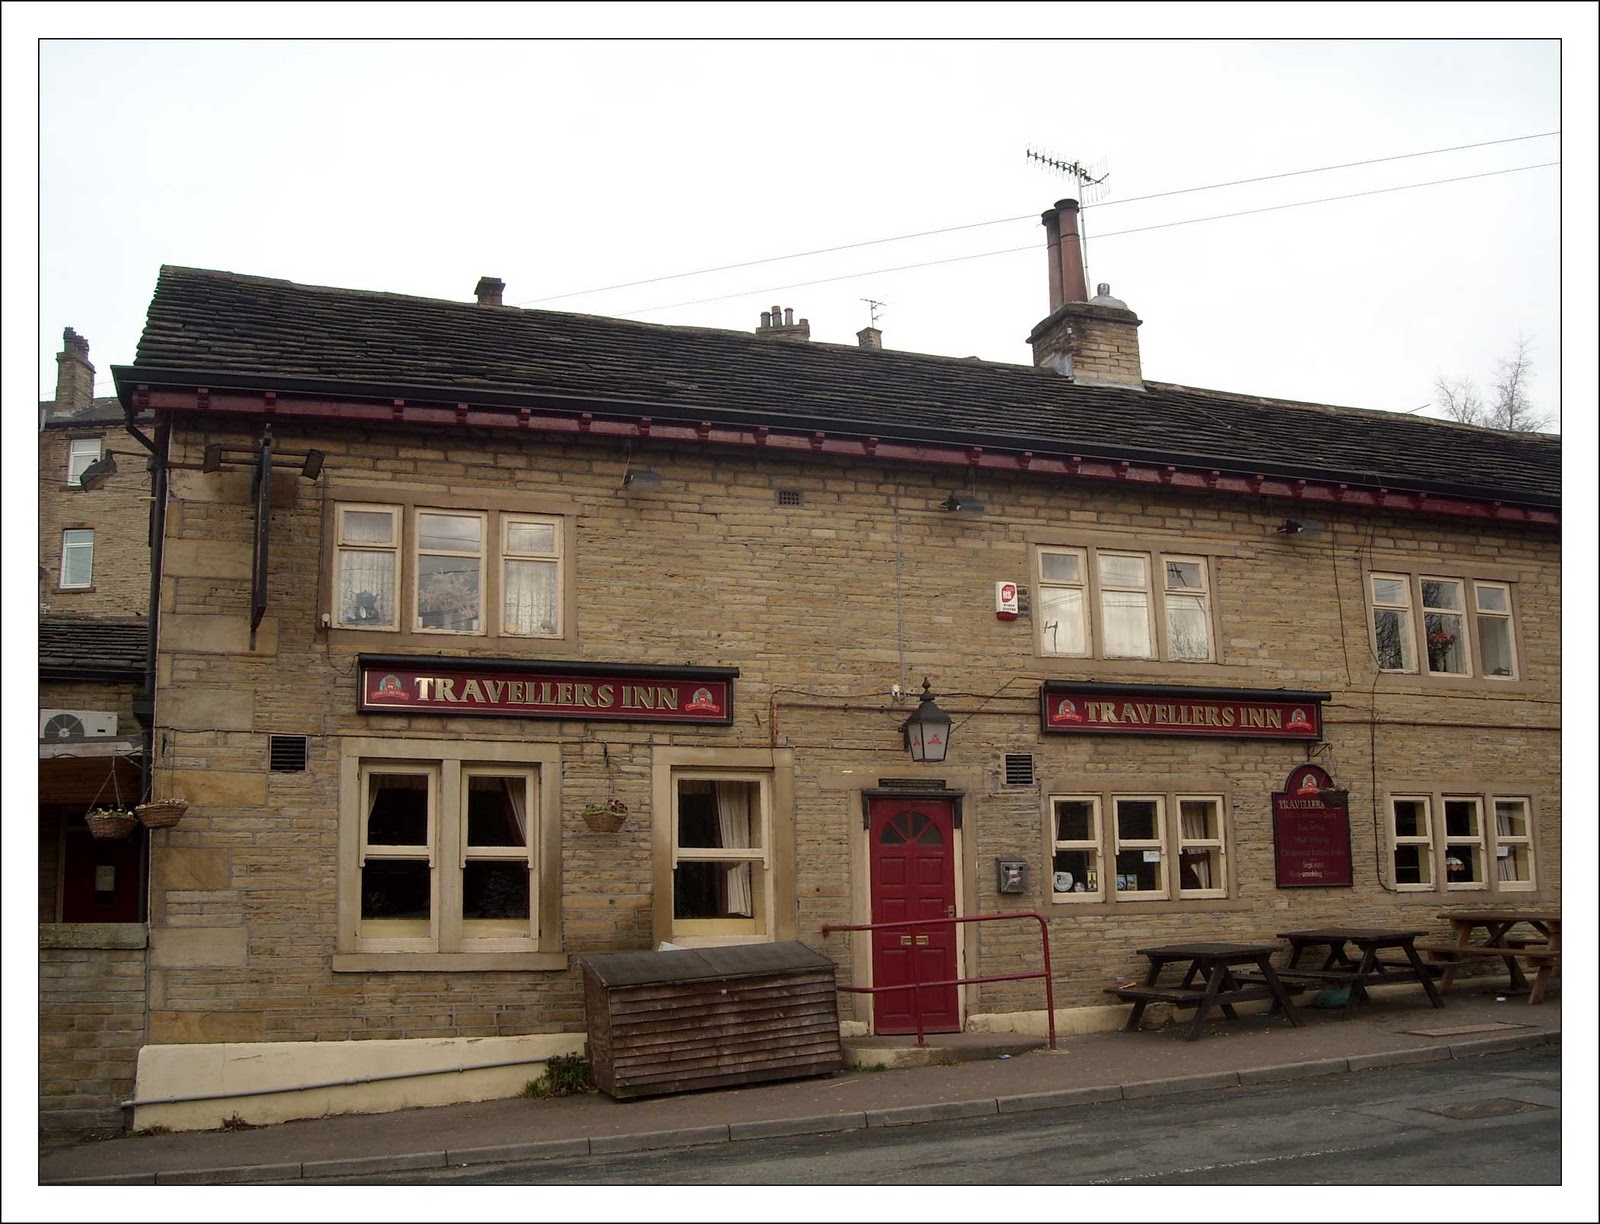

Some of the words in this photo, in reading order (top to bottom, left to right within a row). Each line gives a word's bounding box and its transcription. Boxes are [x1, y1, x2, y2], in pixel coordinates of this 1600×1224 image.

[414, 677, 614, 708] TRAVELLERS
[620, 685, 679, 710] INN
[1084, 701, 1235, 727] TRAVELLERS
[1239, 707, 1282, 729] INN
